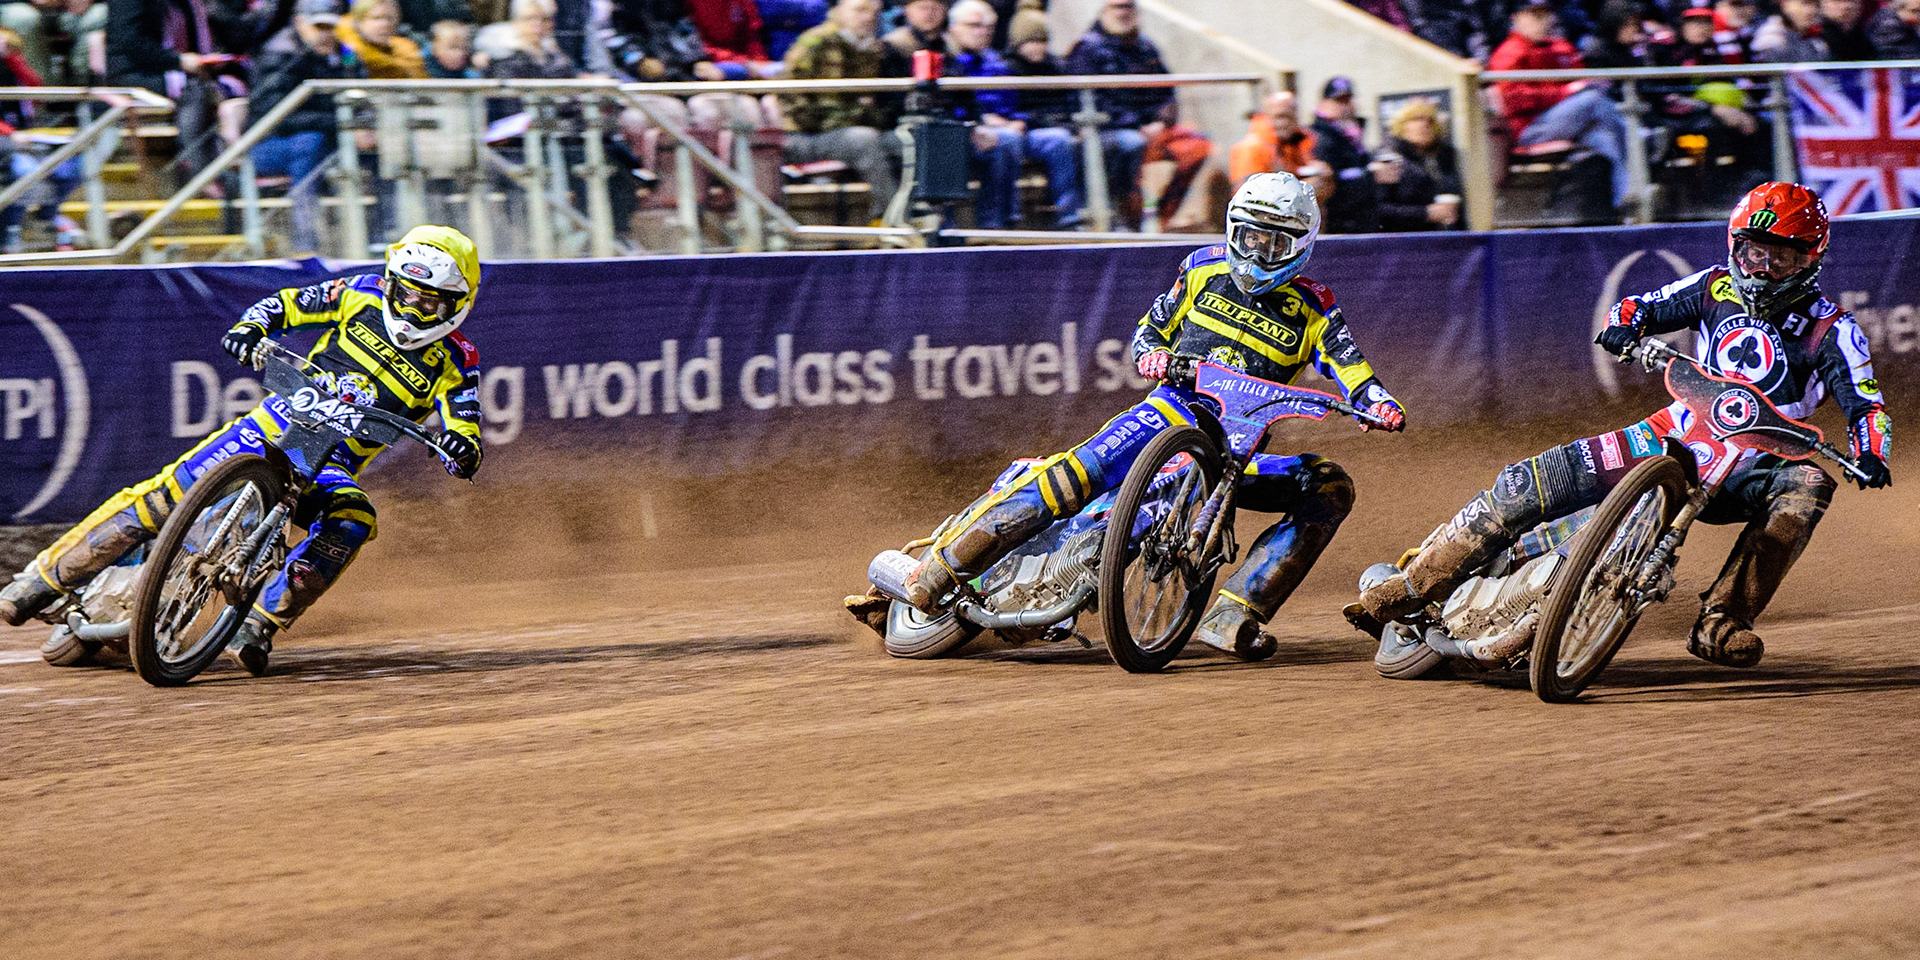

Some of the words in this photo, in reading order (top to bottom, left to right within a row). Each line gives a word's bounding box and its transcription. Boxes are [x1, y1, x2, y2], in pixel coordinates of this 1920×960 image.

[1205, 295, 1237, 317] TRU
[1236, 310, 1292, 342] PLANT
[1282, 297, 1302, 317] 3
[352, 325, 383, 352] TRU
[381, 345, 427, 388] PLANT
[422, 347, 440, 367] 6
[1717, 318, 1745, 339] BELLE
[1749, 319, 1771, 332] VUE
[1770, 334, 1785, 361] ACES
[543, 338, 722, 419] world
[740, 334, 893, 410] class
[909, 321, 1080, 400] travel
[1220, 379, 1238, 391] THE
[1238, 380, 1270, 398] BEACH
[1720, 390, 1739, 400] BELLE
[1577, 440, 1598, 476] DOCUFY
